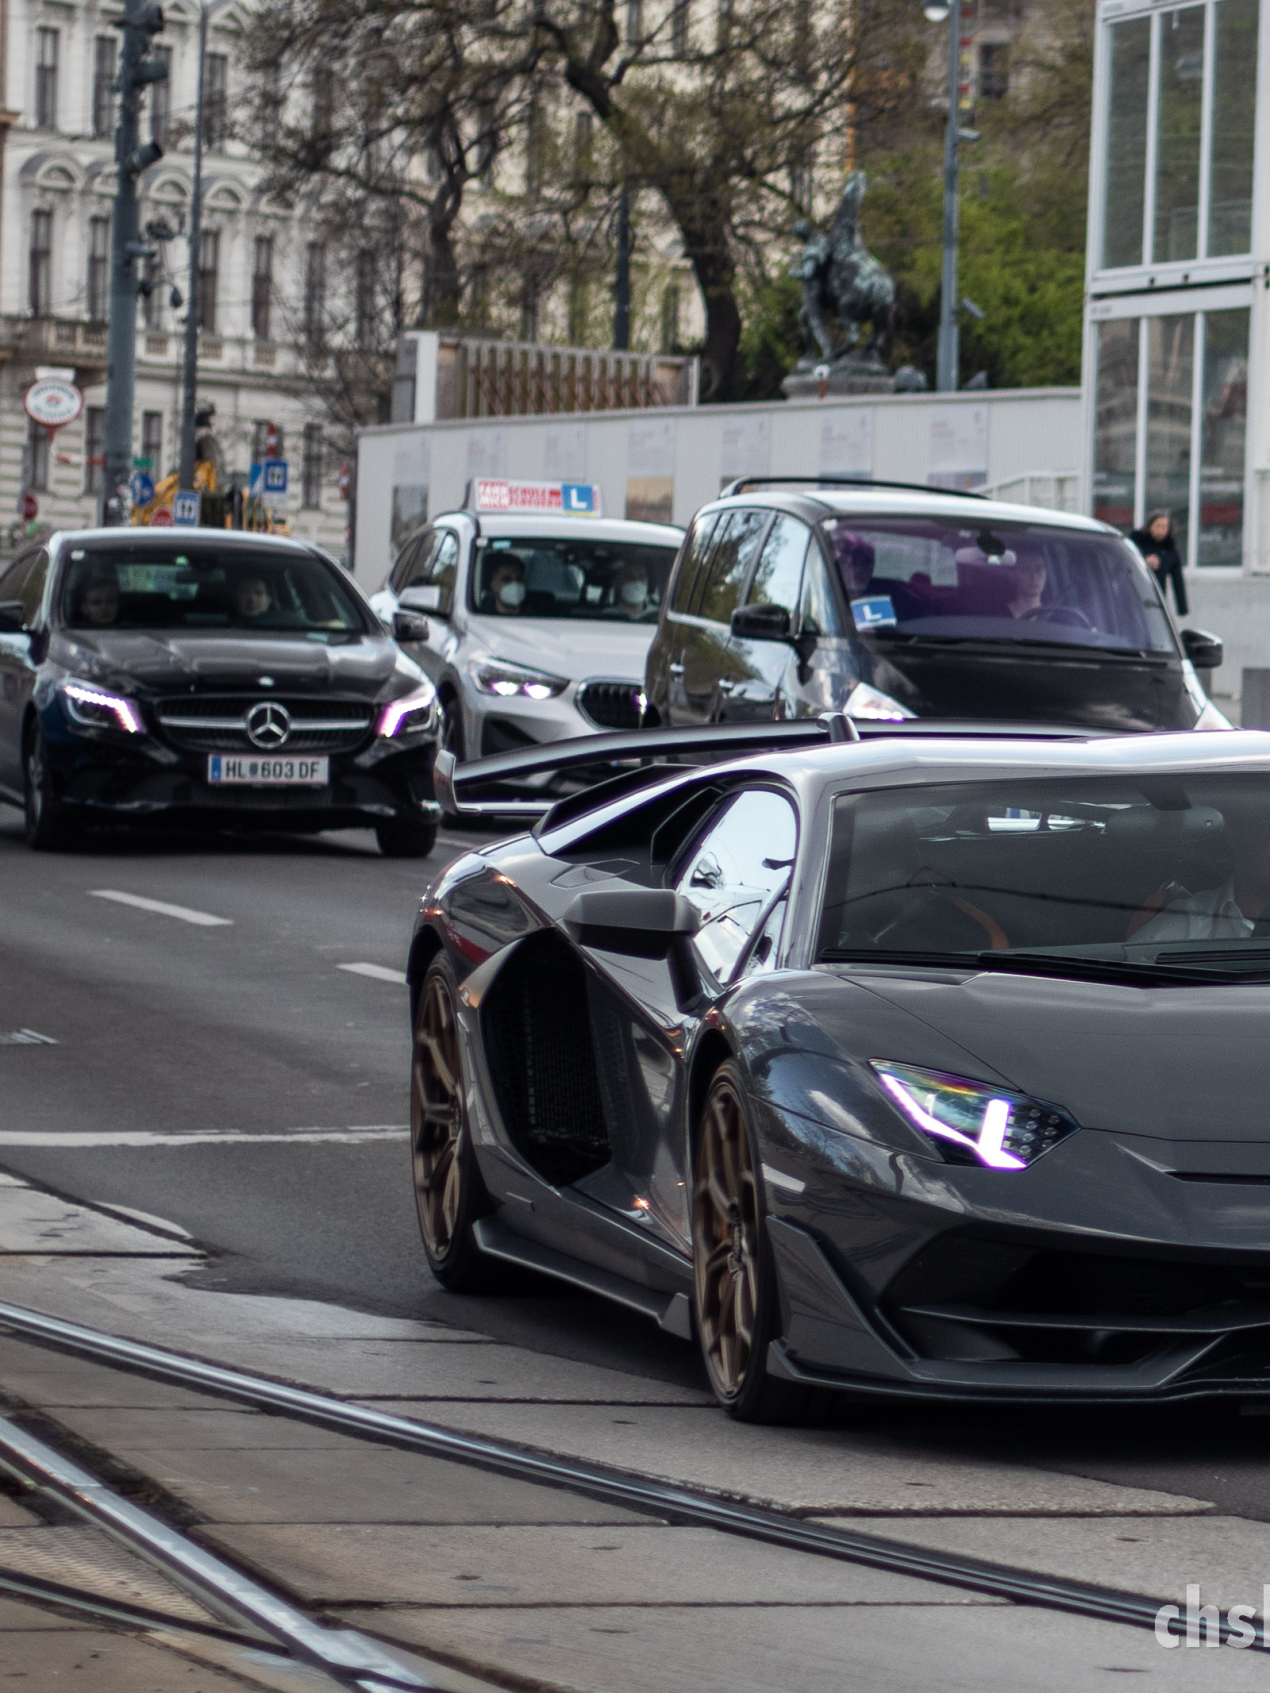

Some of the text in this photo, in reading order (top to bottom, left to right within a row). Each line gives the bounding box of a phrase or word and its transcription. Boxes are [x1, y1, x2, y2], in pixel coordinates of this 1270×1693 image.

[570, 488, 587, 508] L
[862, 604, 883, 620] L
[226, 761, 245, 778] HL
[261, 761, 294, 779] 603
[299, 762, 319, 779] DF
